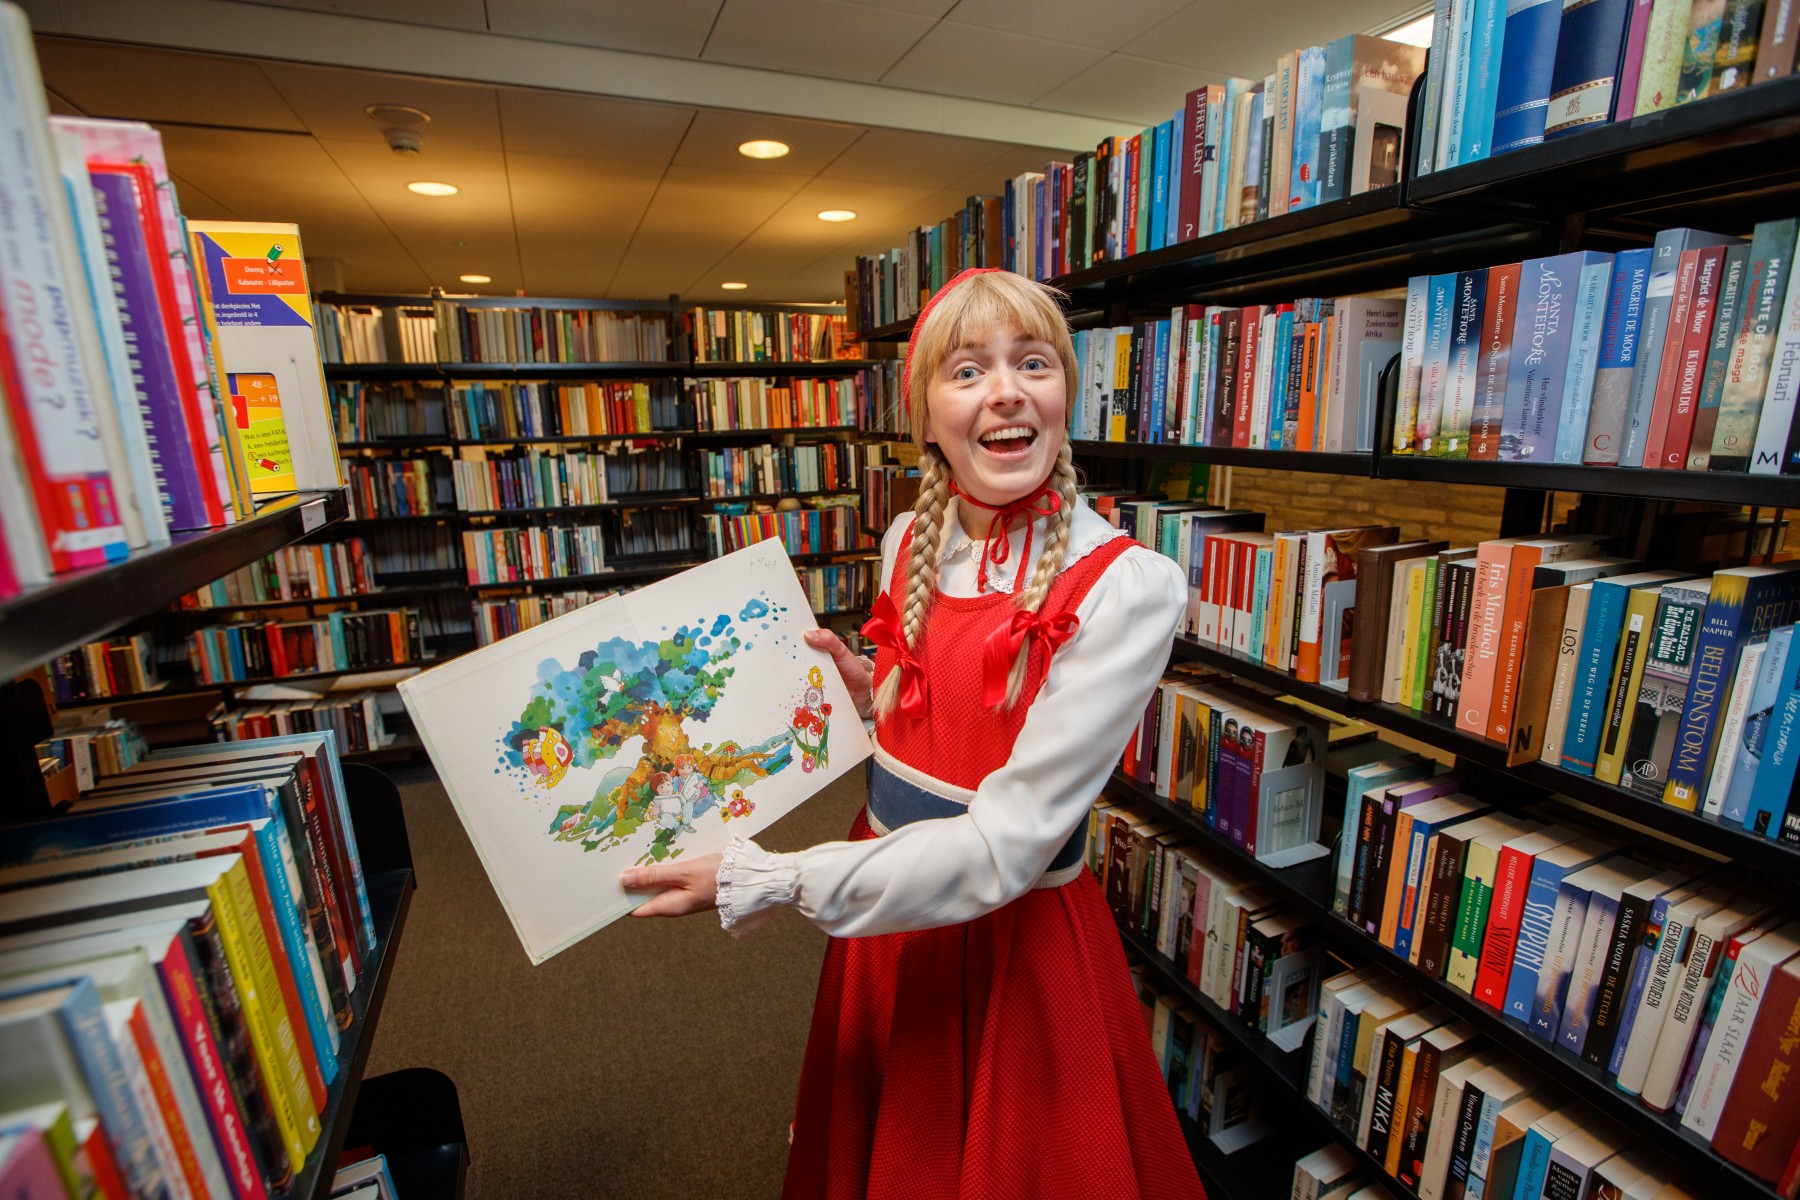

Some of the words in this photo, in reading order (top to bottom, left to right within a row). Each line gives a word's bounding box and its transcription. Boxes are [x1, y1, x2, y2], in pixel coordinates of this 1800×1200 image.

[1460, 31, 1469, 57] Kroniek
[1327, 81, 1348, 92] LEWIN
[1453, 85, 1464, 118] naderende
[1196, 93, 1206, 139] JEFFREY
[1452, 120, 1460, 135] dood
[1193, 143, 1203, 175] LENT
[1327, 144, 1338, 187] prikkeldraad
[1658, 246, 1672, 257] 12
[244, 266, 264, 274] Dwerg
[1697, 258, 1717, 295] Margriet
[1752, 261, 1765, 276] De
[268, 279, 295, 288] Lilliputter
[1499, 276, 1508, 295] Santa
[1627, 269, 1644, 318] MARGRIET
[1723, 260, 1742, 306] MARGRIET
[1758, 259, 1781, 321] MARENTE
[1366, 309, 1380, 318] Henri
[1382, 310, 1398, 320] Lopes
[1456, 276, 1473, 344] MONTEFIORE
[1468, 298, 1478, 322] SANTA
[1494, 295, 1504, 334] Montefiore
[1525, 262, 1562, 366] MONTEFIORE
[1547, 293, 1562, 336] SANTA
[1697, 297, 1709, 308] de
[1722, 308, 1733, 320] DE
[1738, 280, 1761, 345] Nederlandse
[1228, 319, 1237, 339] Tessa
[1366, 320, 1383, 329] Zoeken
[1384, 321, 1398, 330] naar
[1415, 310, 1423, 332] SANTA
[1430, 287, 1445, 352] MONTEFIORE
[1441, 307, 1449, 330] SANTA
[1626, 320, 1638, 332] DE
[1692, 310, 1707, 334] Moor
[1227, 340, 1236, 349] de
[1247, 322, 1255, 344] Tessa
[1365, 330, 1382, 338] Afrika
[1715, 322, 1731, 349] MOOR
[1754, 325, 1767, 340] DE
[1226, 350, 1234, 365] Loo
[1246, 344, 1253, 353] de
[1489, 341, 1501, 373] ONDER
[1620, 334, 1634, 362] MOOR
[1687, 349, 1700, 360] IK
[1245, 355, 1253, 369] Loo
[1430, 360, 1439, 378] Villa
[1731, 348, 1747, 383] maagd
[1746, 344, 1764, 383] MOOR
[1774, 342, 1800, 402] Februari
[252, 380, 262, 388] 48
[1225, 375, 1232, 385] De
[1244, 372, 1251, 382] De
[1487, 374, 1495, 385] DE
[1540, 377, 1550, 390] Het
[1680, 361, 1697, 395] DROOM
[1221, 387, 1231, 415] tweeling
[1239, 384, 1250, 422] tweeling
[1424, 381, 1437, 421] Magdalena
[1481, 386, 1494, 439] OMBU-BOOM
[1678, 396, 1691, 414] DUS
[1534, 392, 1548, 436] vlinderkistje
[256, 432, 260, 440] is
[1311, 561, 1321, 588] Amulya
[1479, 560, 1489, 576] Het
[1489, 562, 1506, 588] Iris
[1476, 578, 1487, 597] boek
[1309, 590, 1318, 615] Malladi
[1475, 599, 1482, 609] en
[1667, 606, 1683, 617] Het
[1473, 611, 1482, 621] de
[1479, 592, 1502, 659] Murdoch
[1512, 620, 1523, 633] DE
[1659, 618, 1681, 635] diepe
[1710, 618, 1728, 627] BILL
[1562, 628, 1578, 656] LOS
[1702, 626, 1733, 638] NAPIER
[1465, 624, 1480, 680] broederschap
[1508, 635, 1518, 657] KLEUR
[1591, 648, 1601, 664] EEN
[1657, 636, 1676, 659] Zuiden
[1774, 641, 1785, 655] Han
[1507, 659, 1515, 672] VAN
[1588, 667, 1597, 684] WEG
[1765, 657, 1780, 684] Nefkens
[1503, 674, 1512, 693] HAAR
[1586, 686, 1594, 696] IN
[1501, 695, 1510, 713] HART
[1584, 699, 1592, 710] DE
[1677, 645, 1725, 772] BEELDENSTORM
[1516, 725, 1532, 753] N
[1577, 712, 1590, 743] WERELD
[1254, 737, 1263, 762] Hisham
[1251, 764, 1261, 787] Matar
[312, 815, 322, 833] Het
[327, 886, 337, 905] huis
[1507, 856, 1518, 879] NELLEKE
[267, 832, 280, 859] Witte
[282, 893, 296, 926] Zwarte
[290, 928, 308, 969] schapen
[1428, 892, 1440, 926] TOSCANE
[1439, 894, 1451, 922] MOORD
[1499, 880, 1513, 920] NOORDERVLIET
[1438, 923, 1446, 932] IN
[1618, 908, 1634, 938] SASKIA
[1653, 910, 1664, 922] 13
[1513, 899, 1555, 976] SNIJPUNT
[1483, 923, 1513, 977] SNIJPUNT
[1610, 942, 1626, 972] NOORT
[1607, 975, 1616, 986] DE
[1734, 963, 1760, 1000] 12
[1597, 989, 1613, 1026] EETCLUB
[1730, 991, 1752, 1021] JAAR
[194, 1021, 218, 1073] Voor
[1388, 1041, 1398, 1058] Elsa
[1718, 1026, 1741, 1064] SLAAF
[1383, 1059, 1395, 1086] Osorio
[1402, 1058, 1413, 1074] Elsa
[1398, 1075, 1409, 1099] Osorio
[1372, 1085, 1393, 1134] MIKA
[1414, 1106, 1424, 1118] De
[1464, 1094, 1479, 1120] Vincent
[1391, 1102, 1404, 1142] UITWEG
[1407, 1119, 1420, 1151] gevangene
[1459, 1121, 1473, 1152] Overeem
